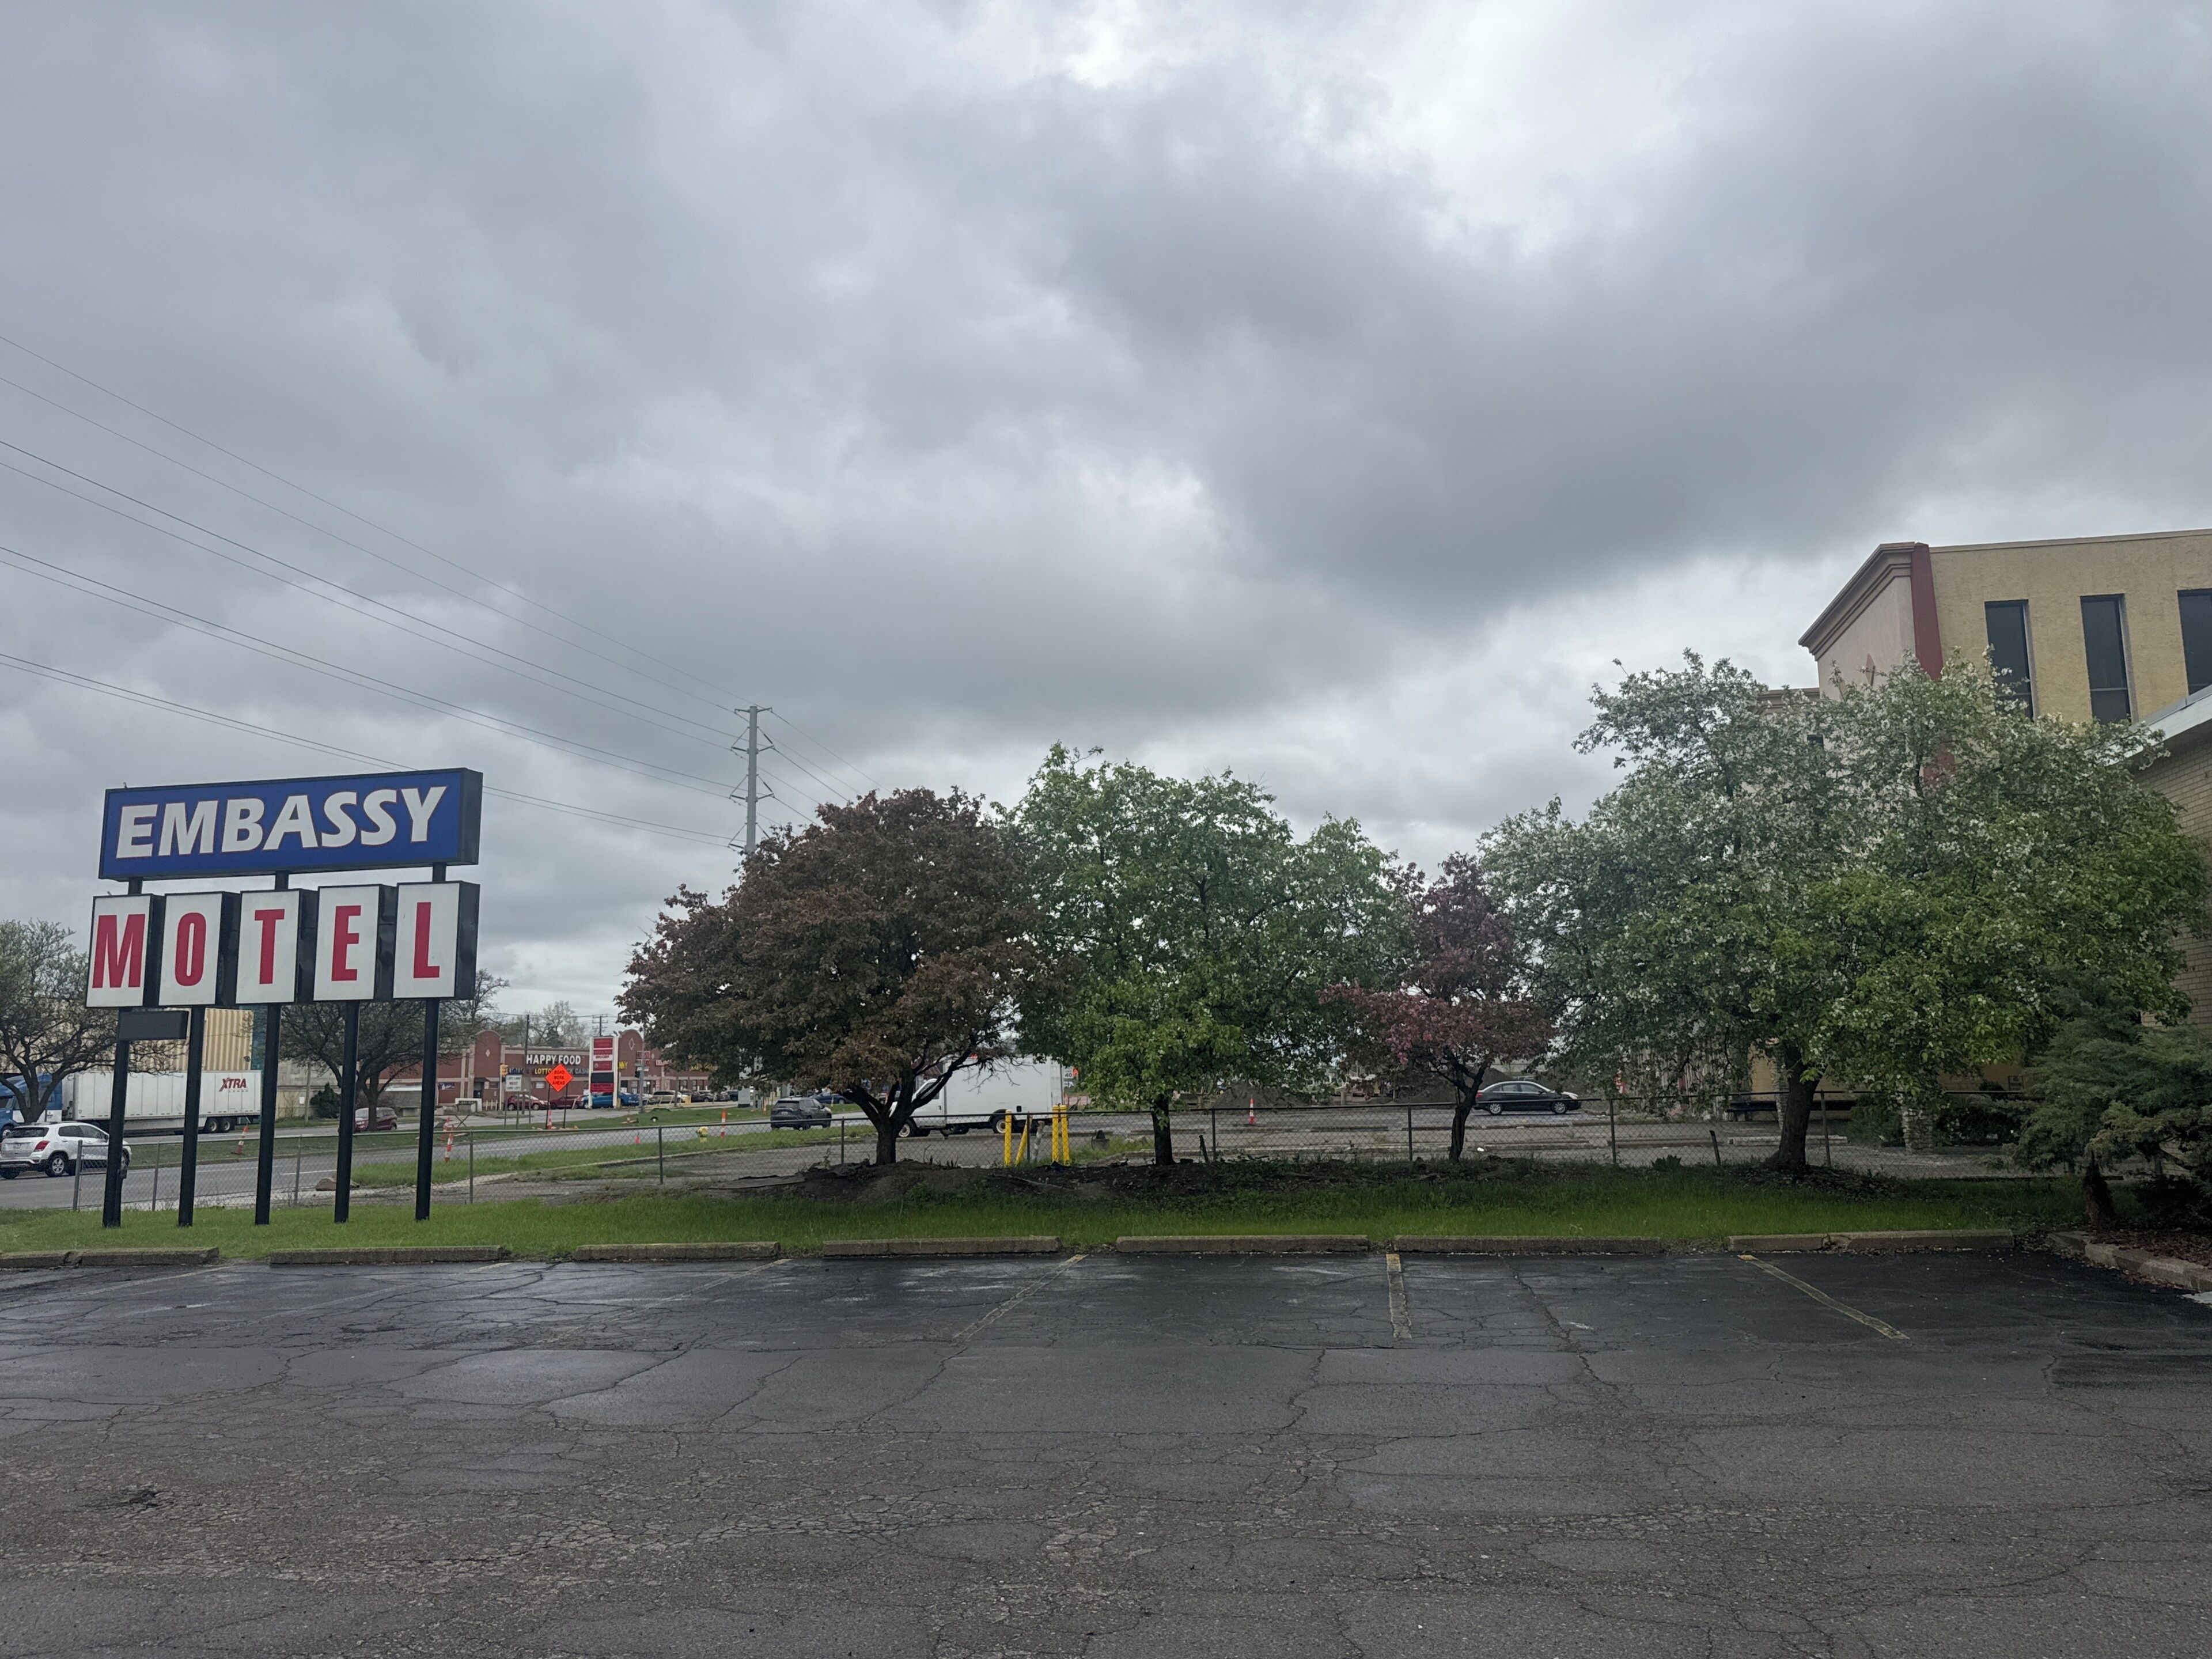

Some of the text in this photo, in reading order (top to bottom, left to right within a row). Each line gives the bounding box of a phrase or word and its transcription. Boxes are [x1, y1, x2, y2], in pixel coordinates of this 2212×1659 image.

[116, 785, 448, 859] EMBASSY
[92, 902, 440, 989] MOTEL
[526, 1054, 581, 1065] HAPPY FOOD
[219, 1077, 247, 1092] XTRA
